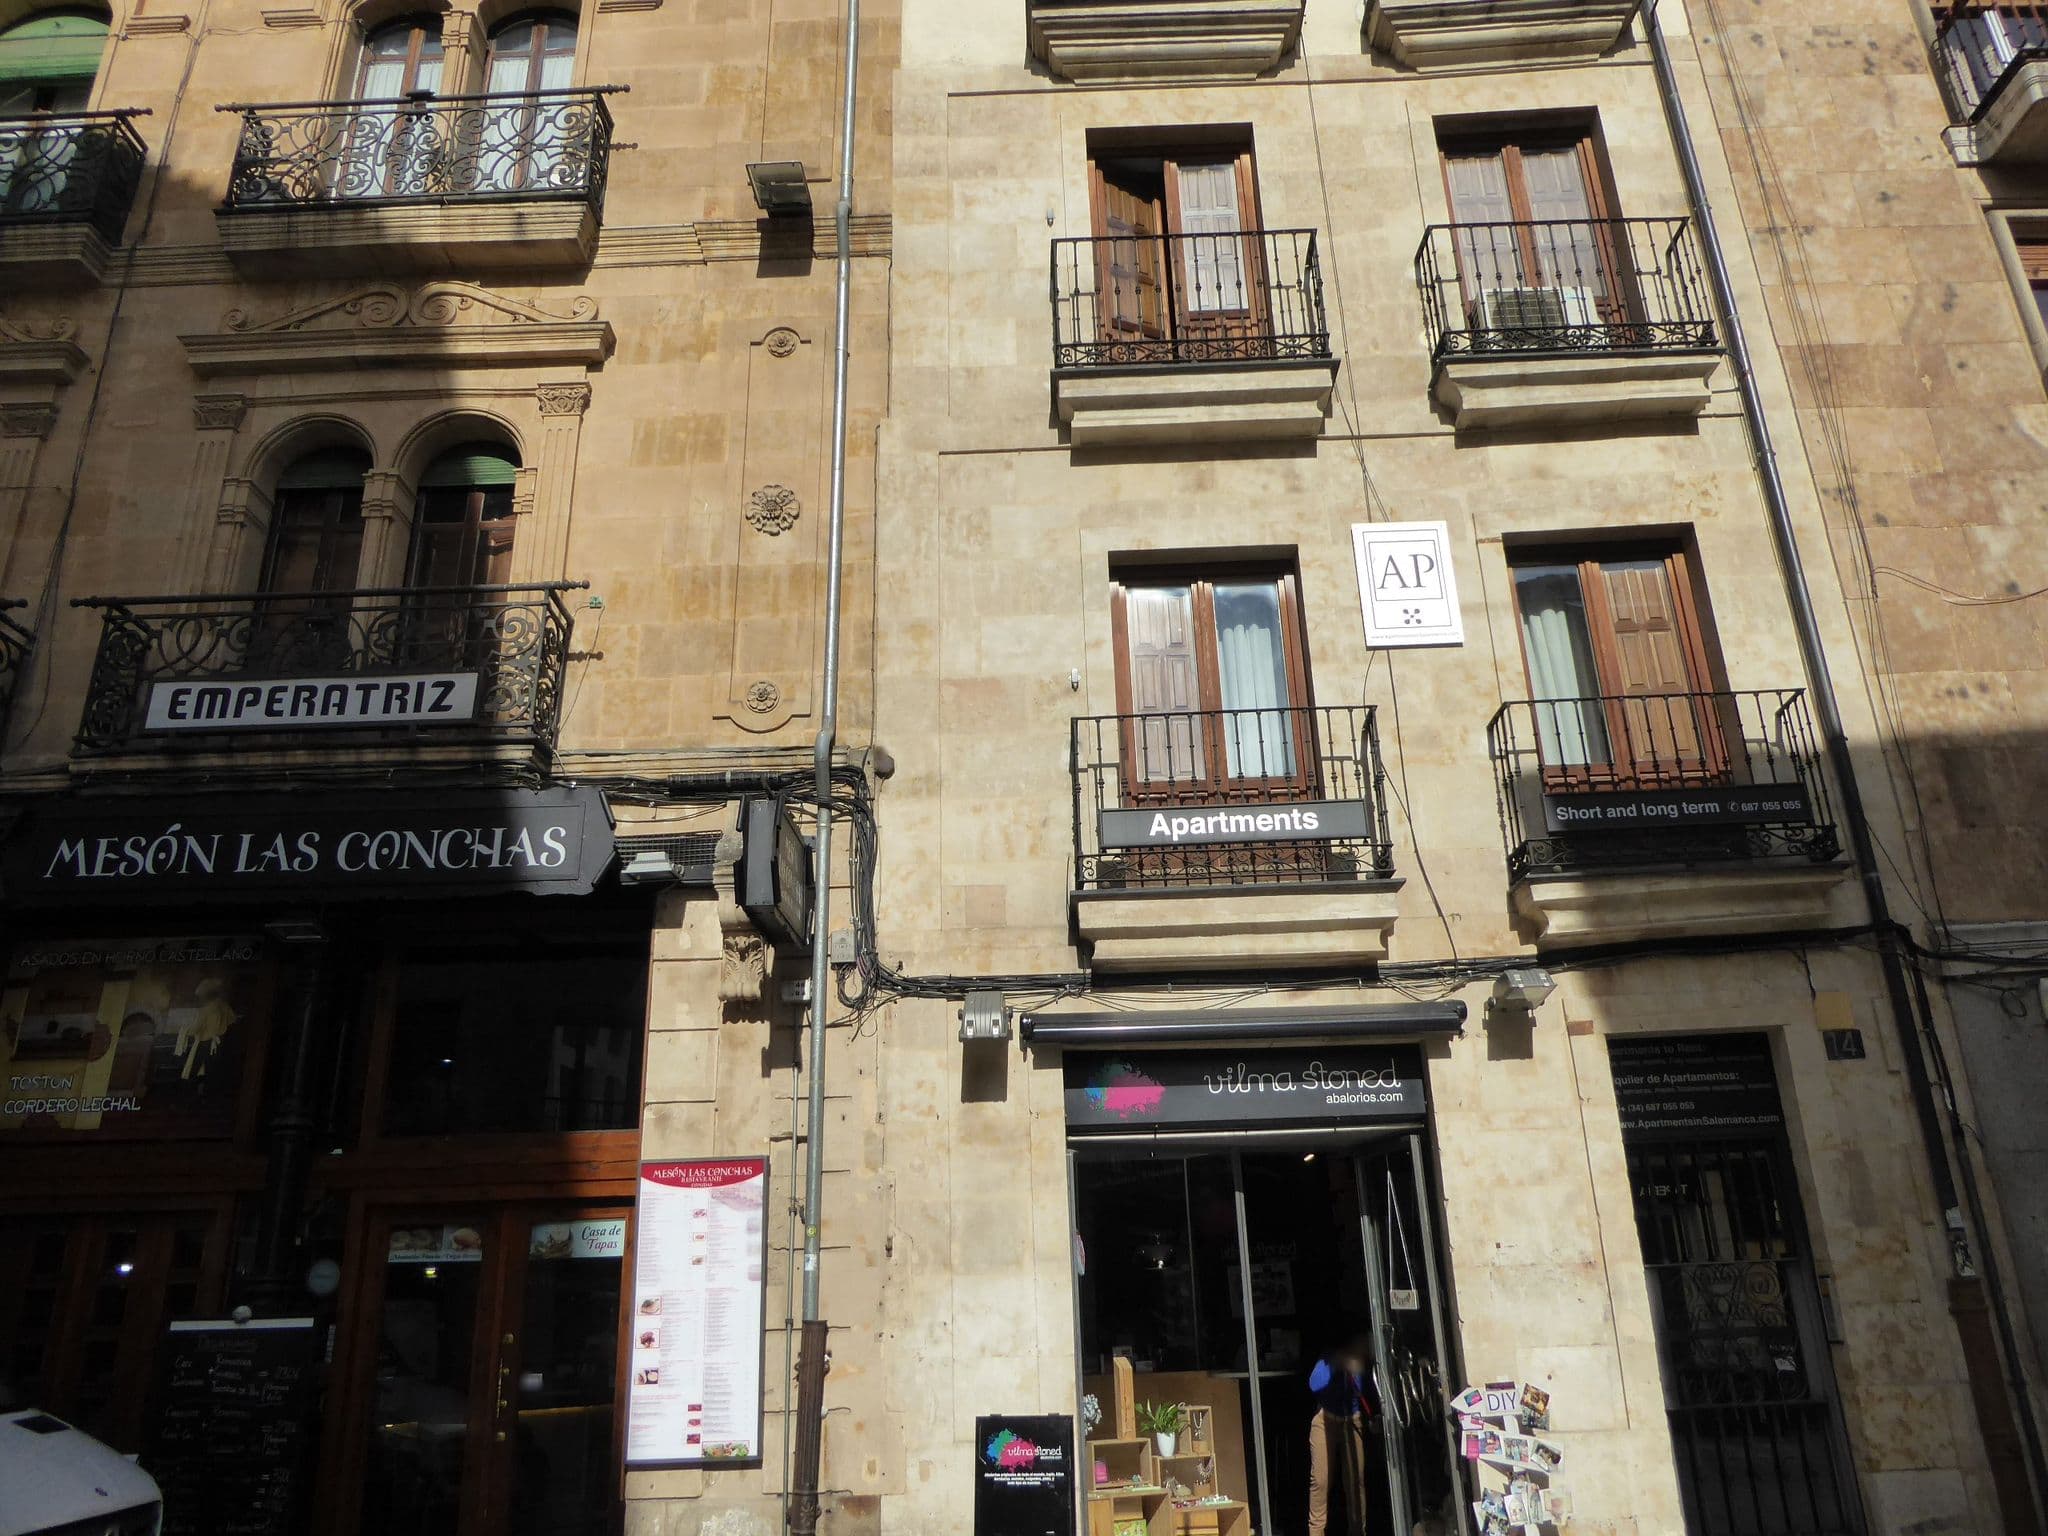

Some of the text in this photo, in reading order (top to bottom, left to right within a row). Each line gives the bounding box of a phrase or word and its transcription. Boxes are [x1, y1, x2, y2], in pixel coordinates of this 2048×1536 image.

[1376, 554, 1434, 589] AP
[167, 680, 456, 720] EMPERATRIZ
[1556, 800, 1801, 821] Short and long term 687 055 055
[1149, 808, 1319, 841] Apartments
[43, 824, 567, 880] MESÓN LAS CONCHAS
[1829, 1031, 1857, 1057] 14
[1203, 1058, 1402, 1095] vilma stoned
[1647, 1073, 1660, 1084] de
[3, 1096, 143, 1115] CORDERO LECHAL
[1326, 1092, 1404, 1105] abalorios.com
[689, 1168, 706, 1178] LAS
[582, 1224, 622, 1240] Casa de
[587, 1237, 618, 1253] Tapas
[1487, 1391, 1516, 1412] DIY
